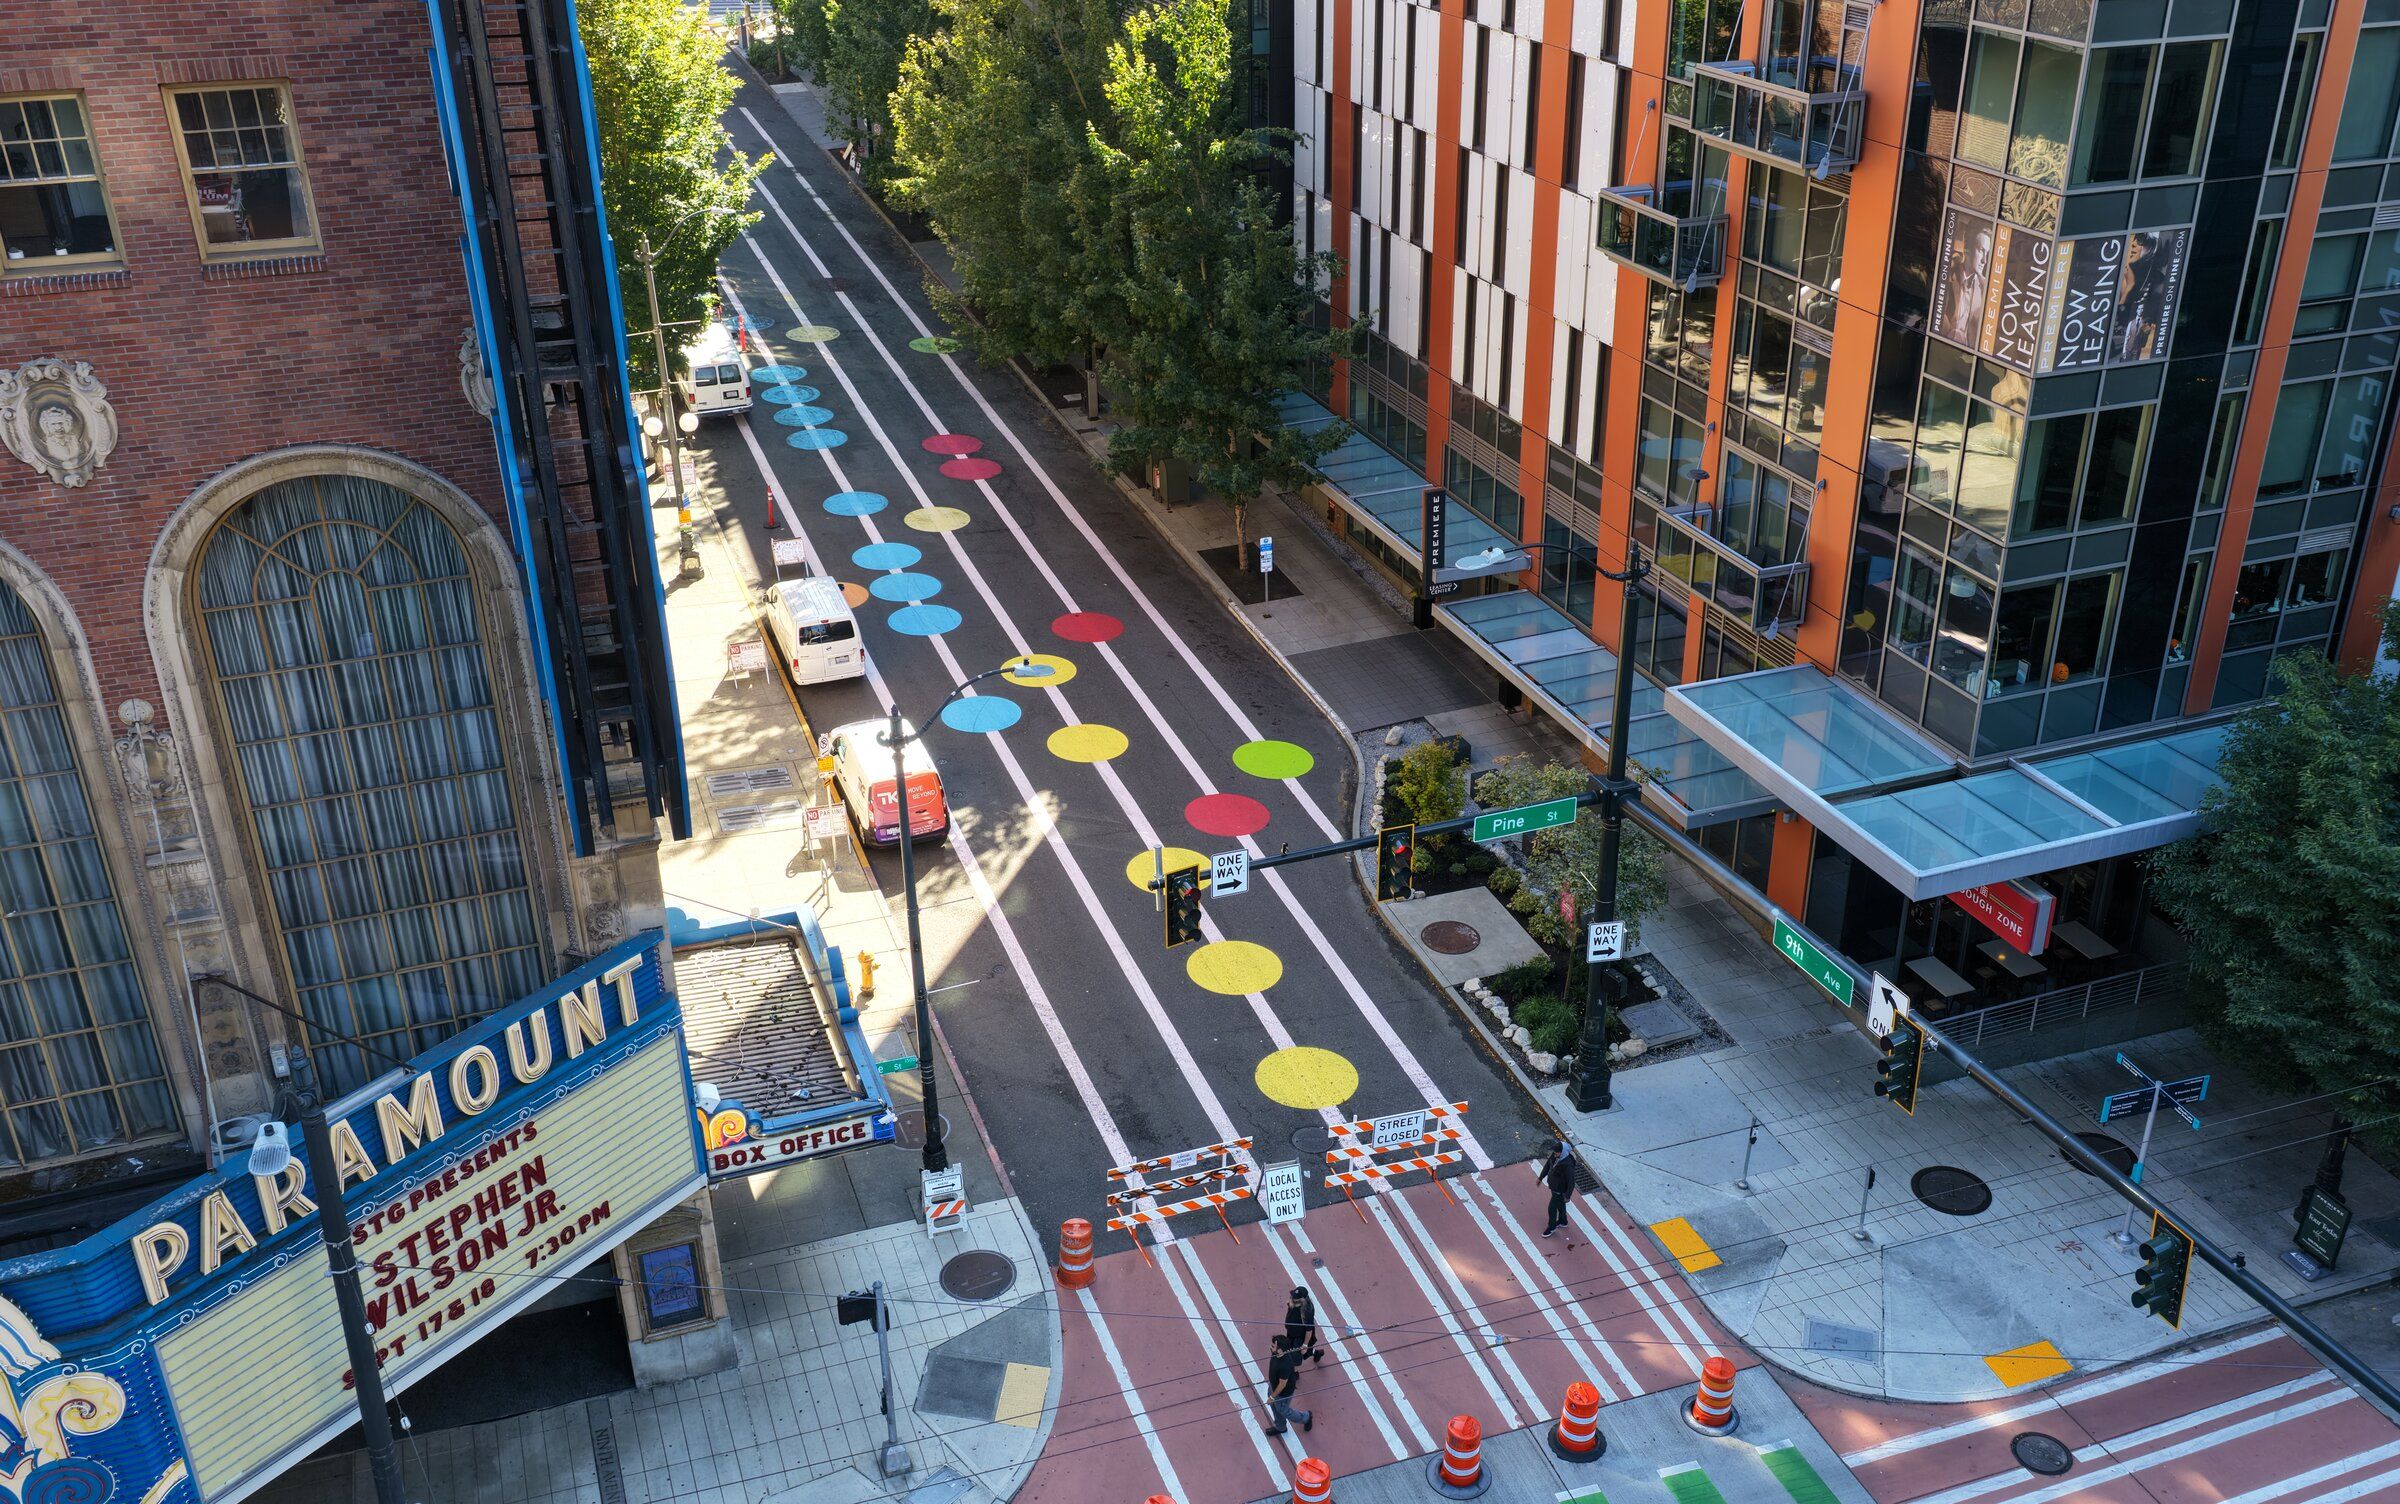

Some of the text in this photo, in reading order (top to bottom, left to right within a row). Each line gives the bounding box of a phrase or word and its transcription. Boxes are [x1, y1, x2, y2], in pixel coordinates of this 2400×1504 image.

[1934, 212, 1956, 332] PREMIERE ON PINE.COM
[1983, 228, 2008, 353] PREMIERE
[2081, 239, 2121, 364] LEASING
[2155, 230, 2186, 355] PREMIERE ON PINE.COM
[2015, 241, 2050, 369] LEASING
[2041, 242, 2070, 369] PREMIERE
[1996, 279, 2023, 361] NOW
[2058, 289, 2088, 368] NOW
[1432, 496, 1440, 565] PREMIERE
[1430, 583, 1452, 591] LEASING
[730, 646, 740, 654] NO
[907, 785, 923, 794] MOVE
[912, 790, 935, 800] BEYOND
[808, 809, 818, 820] NO
[1493, 811, 1558, 833] Pine St
[1217, 865, 1242, 878] WAY
[1218, 854, 1242, 867] ONE
[1595, 925, 1618, 935] ONE
[1997, 912, 2023, 936] ZONE
[1593, 935, 1617, 946] WAY
[1785, 934, 1840, 991] 9th Ave
[131, 954, 643, 1306] PARAMOUNT
[1377, 1128, 1420, 1144] CLOSED
[1379, 1115, 1420, 1131] STREET
[714, 1122, 866, 1171] BOX OFFICE
[352, 1121, 537, 1246] STG PRESENTS
[1270, 1171, 1297, 1187] LOCAL
[1269, 1187, 1301, 1203] ACCESS
[2317, 1194, 2344, 1217] PREMIERE
[373, 1154, 547, 1288] STEPHEN
[1276, 1203, 1297, 1217] ONLY
[2308, 1213, 2338, 1240] Tour Today
[366, 1188, 566, 1332] WILSON JR.
[341, 1334, 407, 1391] SPT
[595, 1427, 614, 1466] NINTH
